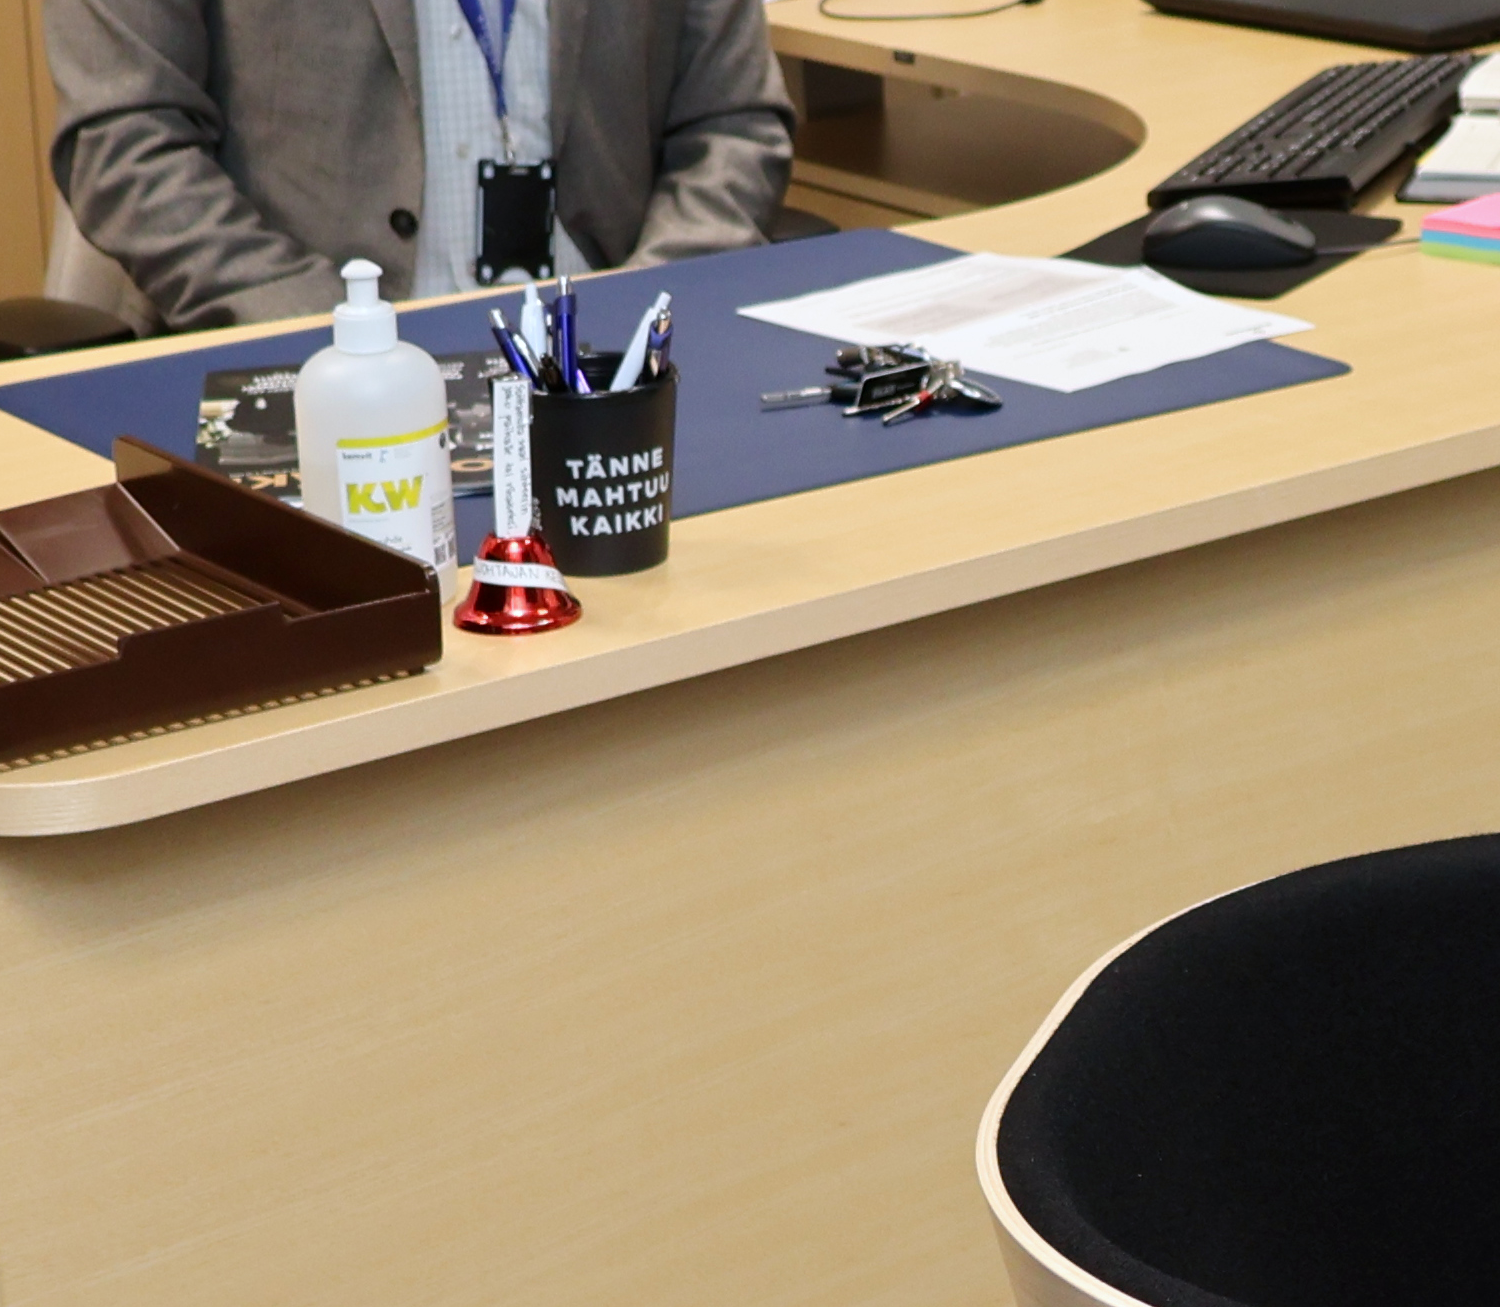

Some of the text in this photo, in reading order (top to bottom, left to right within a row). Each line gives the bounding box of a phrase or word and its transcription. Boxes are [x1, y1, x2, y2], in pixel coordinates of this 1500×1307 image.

[565, 446, 664, 480] TÄNNE
[345, 474, 425, 514] KW
[555, 471, 670, 508] MAHTUU
[570, 502, 664, 537] KAIKKI
